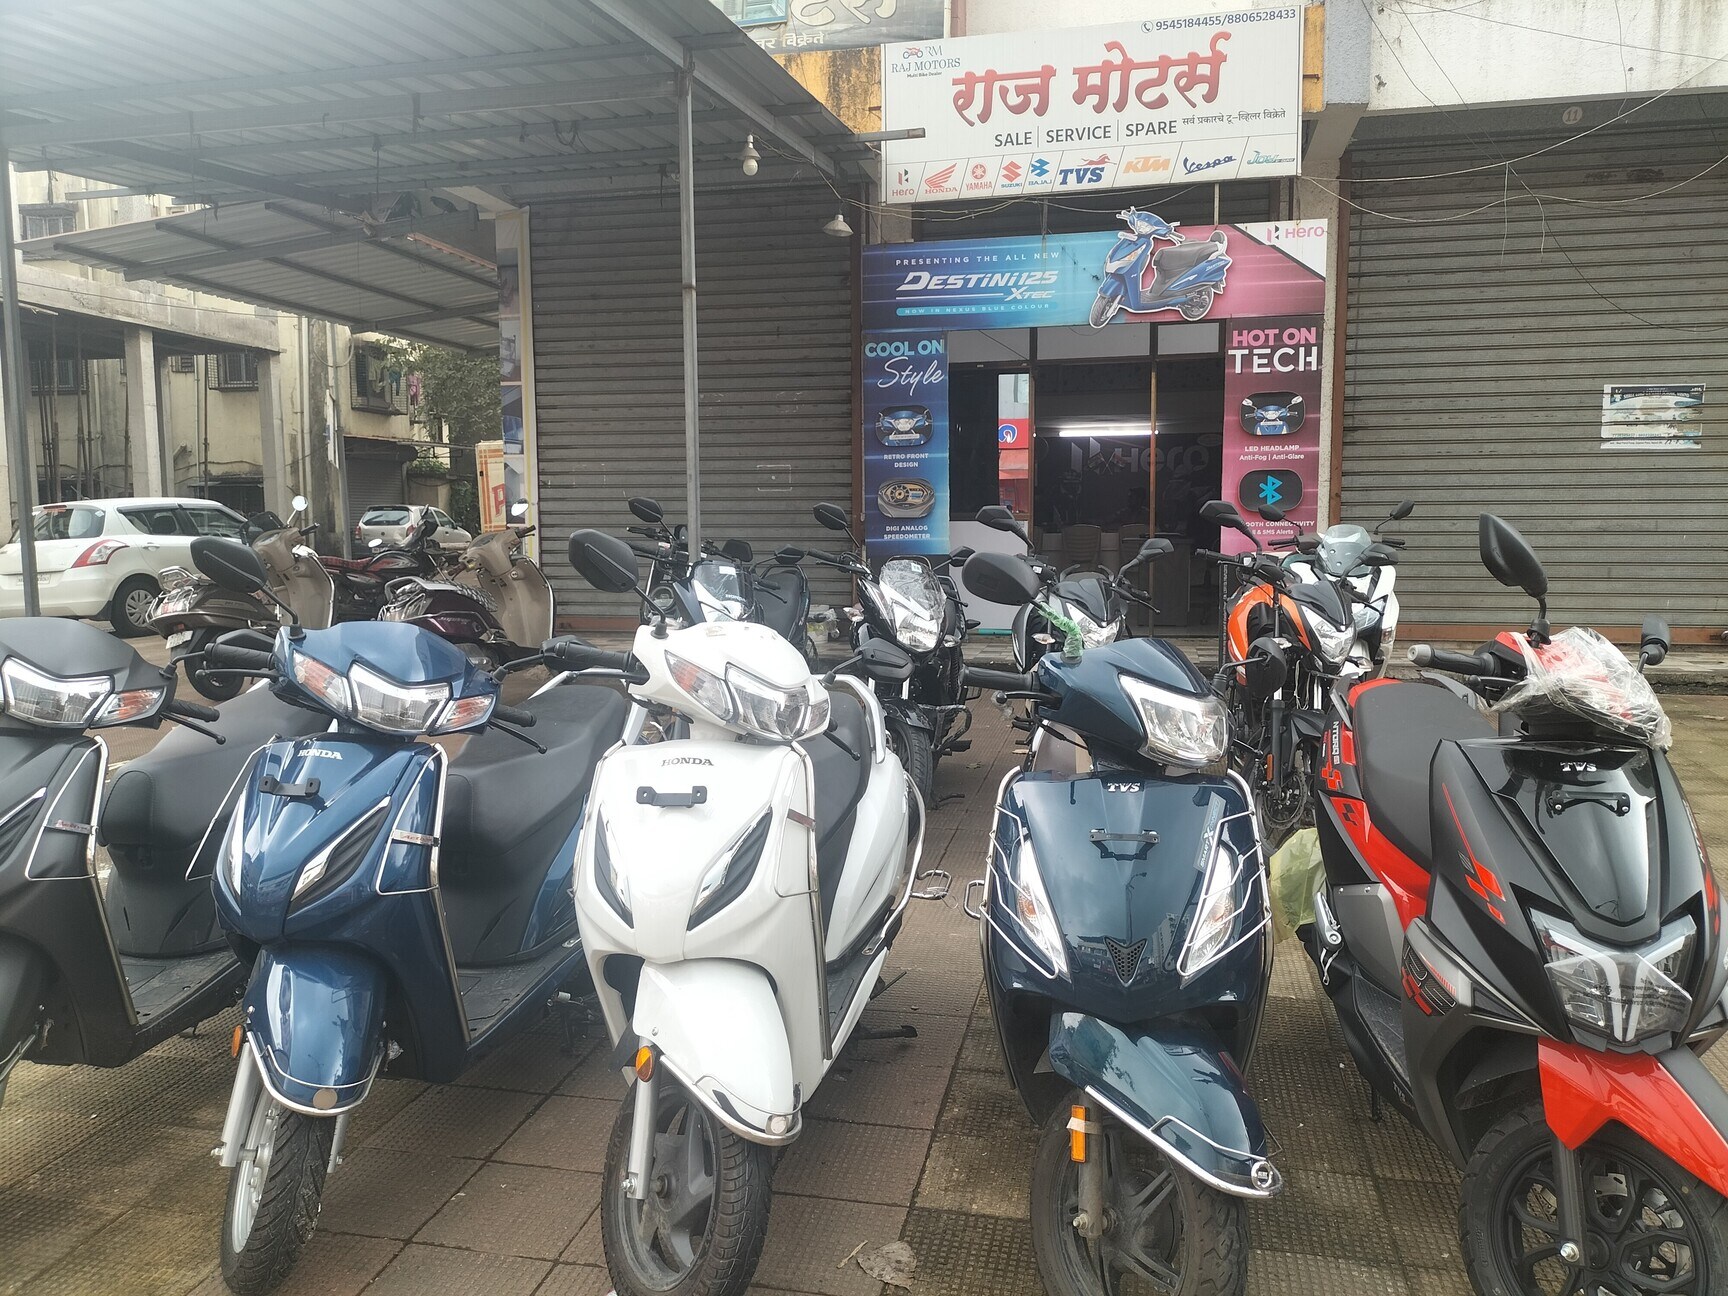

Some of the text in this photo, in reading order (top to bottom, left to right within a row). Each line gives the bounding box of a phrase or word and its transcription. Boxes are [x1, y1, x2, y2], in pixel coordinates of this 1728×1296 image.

[1156, 9, 1296, 30] 9545184455/8806528433
[782, 32, 824, 48] विक्रेते
[891, 57, 961, 73] RAJ MOTORS
[952, 31, 1232, 127] राज मोटर्स
[1182, 114, 1195, 126] सर्व
[1197, 112, 1224, 125] प्रकारचे
[1263, 108, 1286, 119] विक्रेते
[994, 120, 1178, 148] SALE SERVICE SPARE
[1123, 155, 1171, 174] KTM
[1183, 155, 1237, 175] Vespa
[1058, 167, 1105, 185] TVS
[925, 186, 958, 195] HONDA
[966, 181, 993, 191] YAMAHA
[896, 256, 970, 266] PRESENTING
[1232, 327, 1317, 347] HOT ON
[864, 339, 945, 357] COOL ON
[1228, 346, 1318, 374] TECH
[877, 356, 945, 396] Style
[297, 748, 343, 760] HONDA
[661, 757, 714, 767] HONDA
[1107, 782, 1140, 793] TVS
